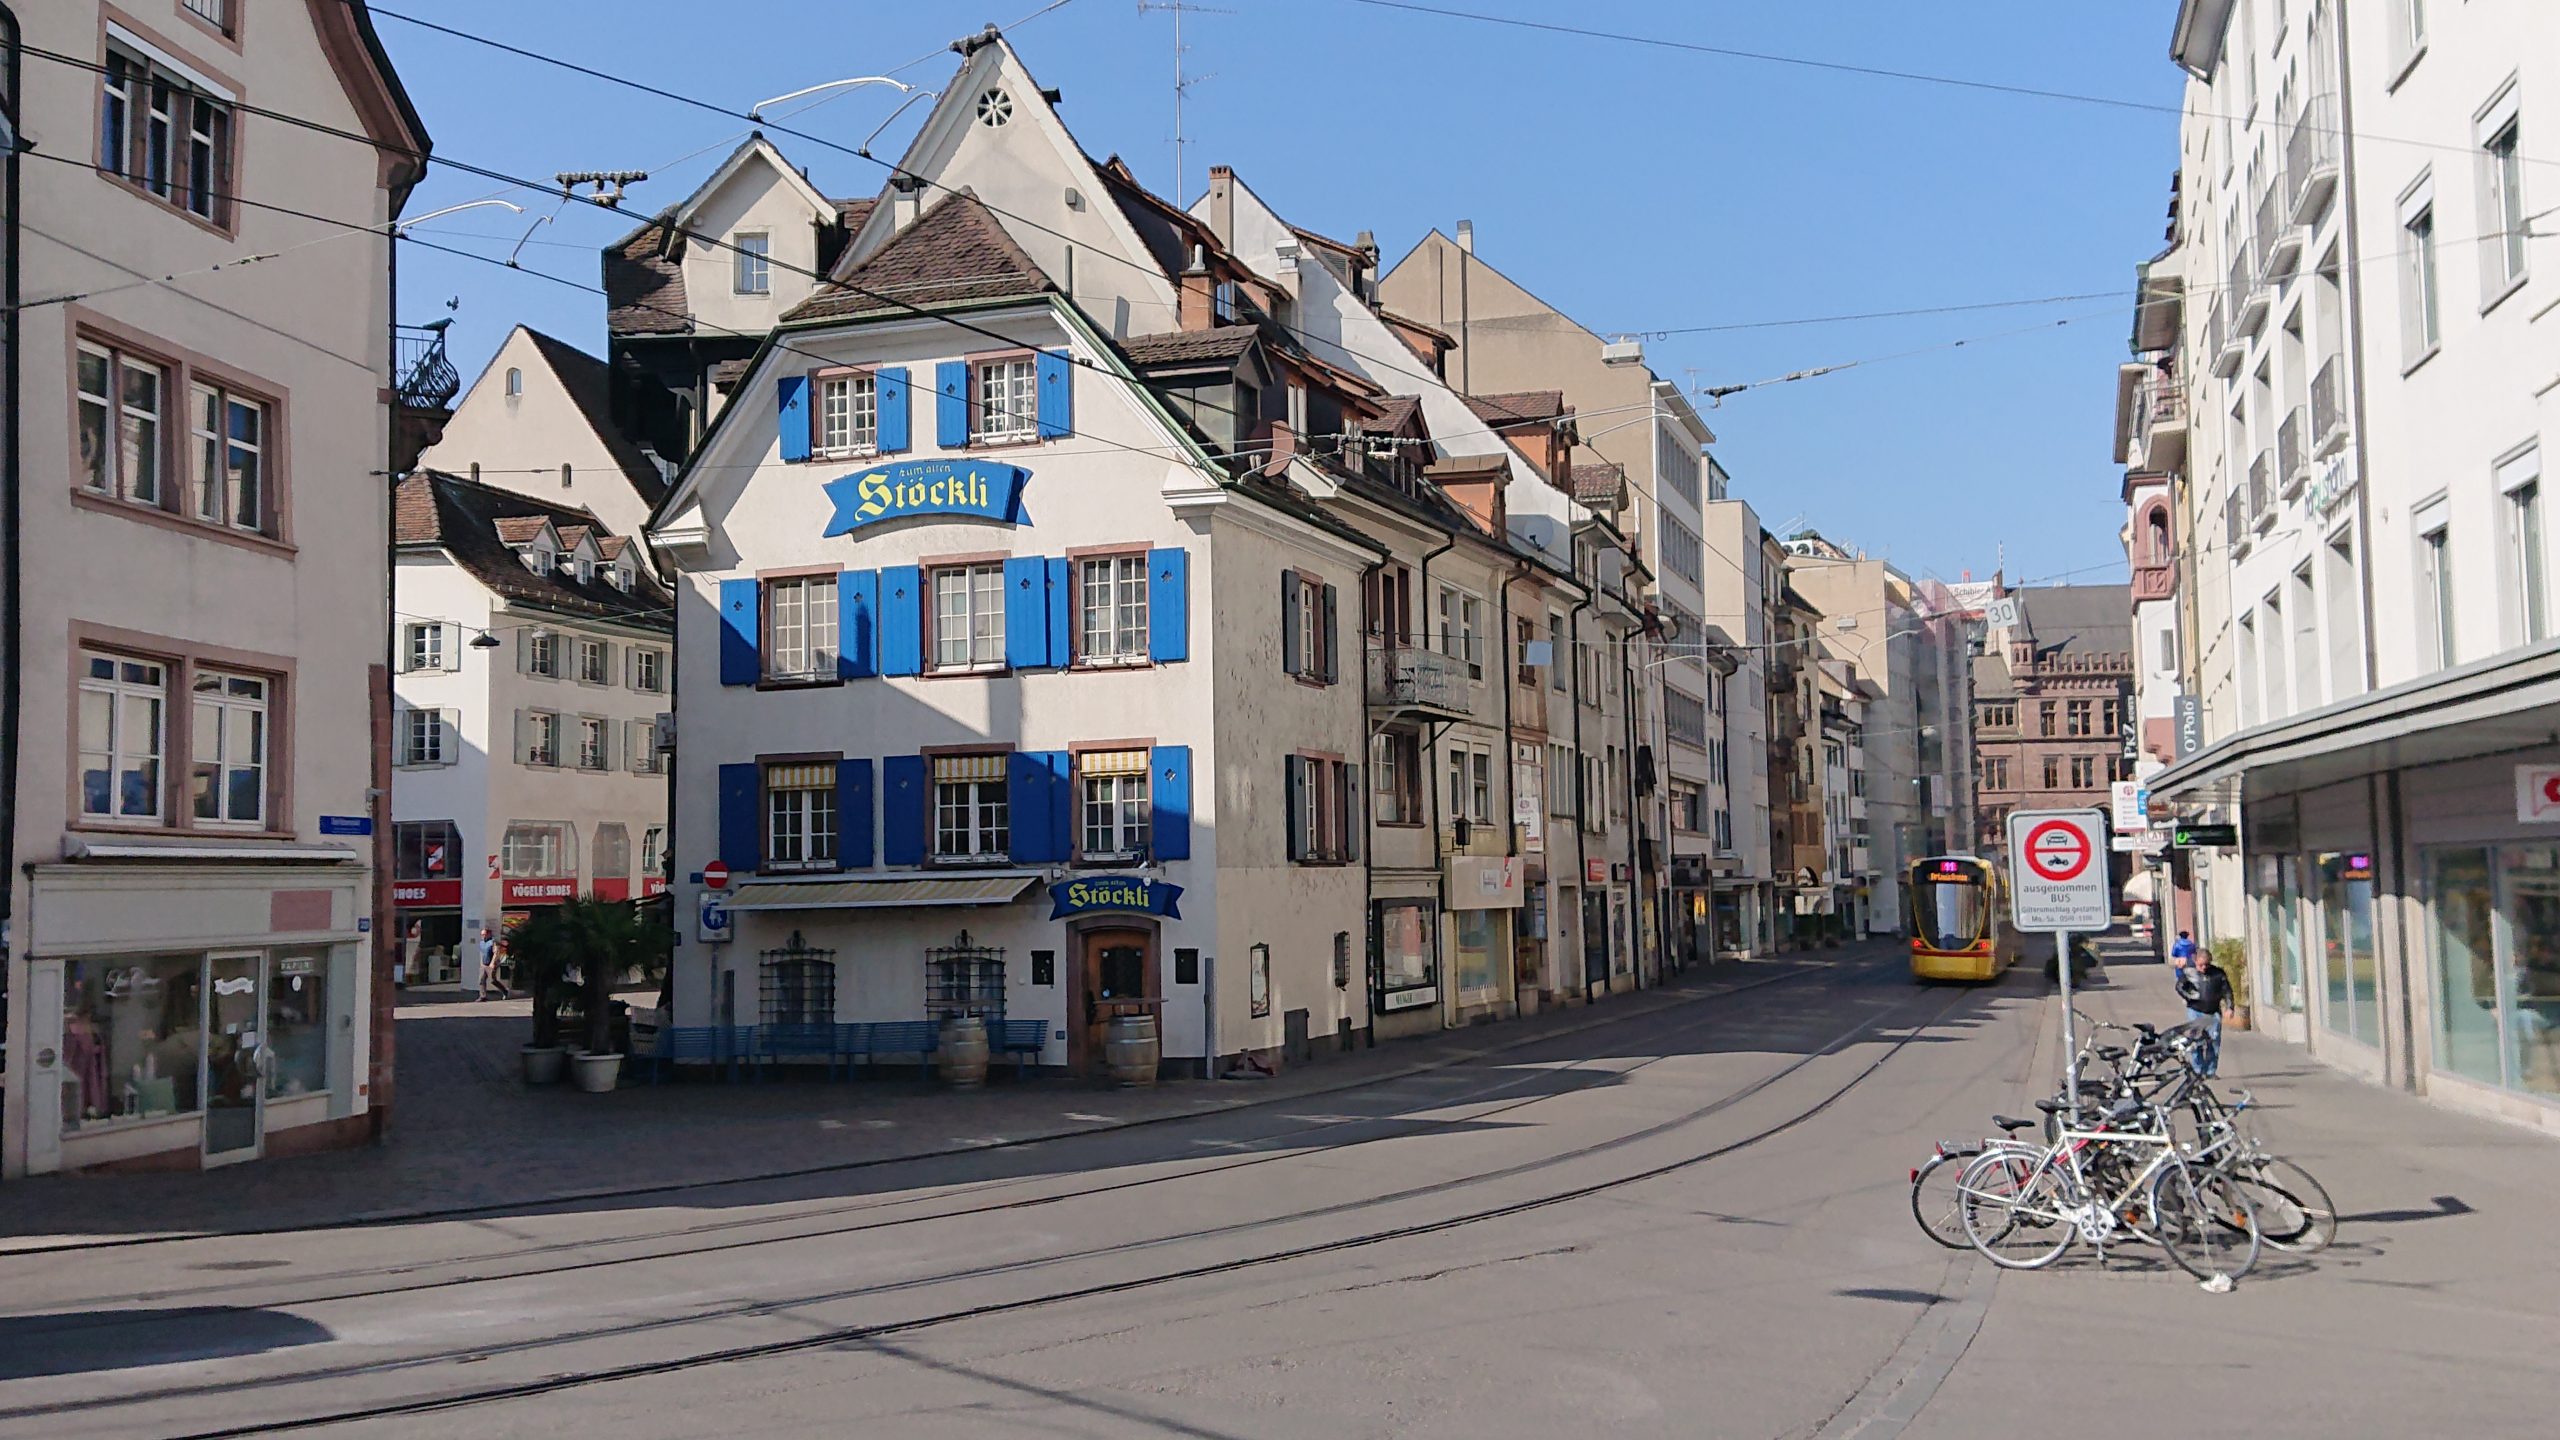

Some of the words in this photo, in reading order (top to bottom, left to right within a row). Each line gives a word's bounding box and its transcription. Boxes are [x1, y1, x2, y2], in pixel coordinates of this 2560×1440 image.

[854, 470, 988, 522] Stöckli
[1989, 604, 2013, 623] 30
[2123, 723, 2137, 759] PKZ
[546, 884, 571, 896] SHOES
[1068, 882, 1150, 908] Stöckli
[2023, 884, 2097, 895] ausgenommen
[2050, 893, 2071, 903] BUS
